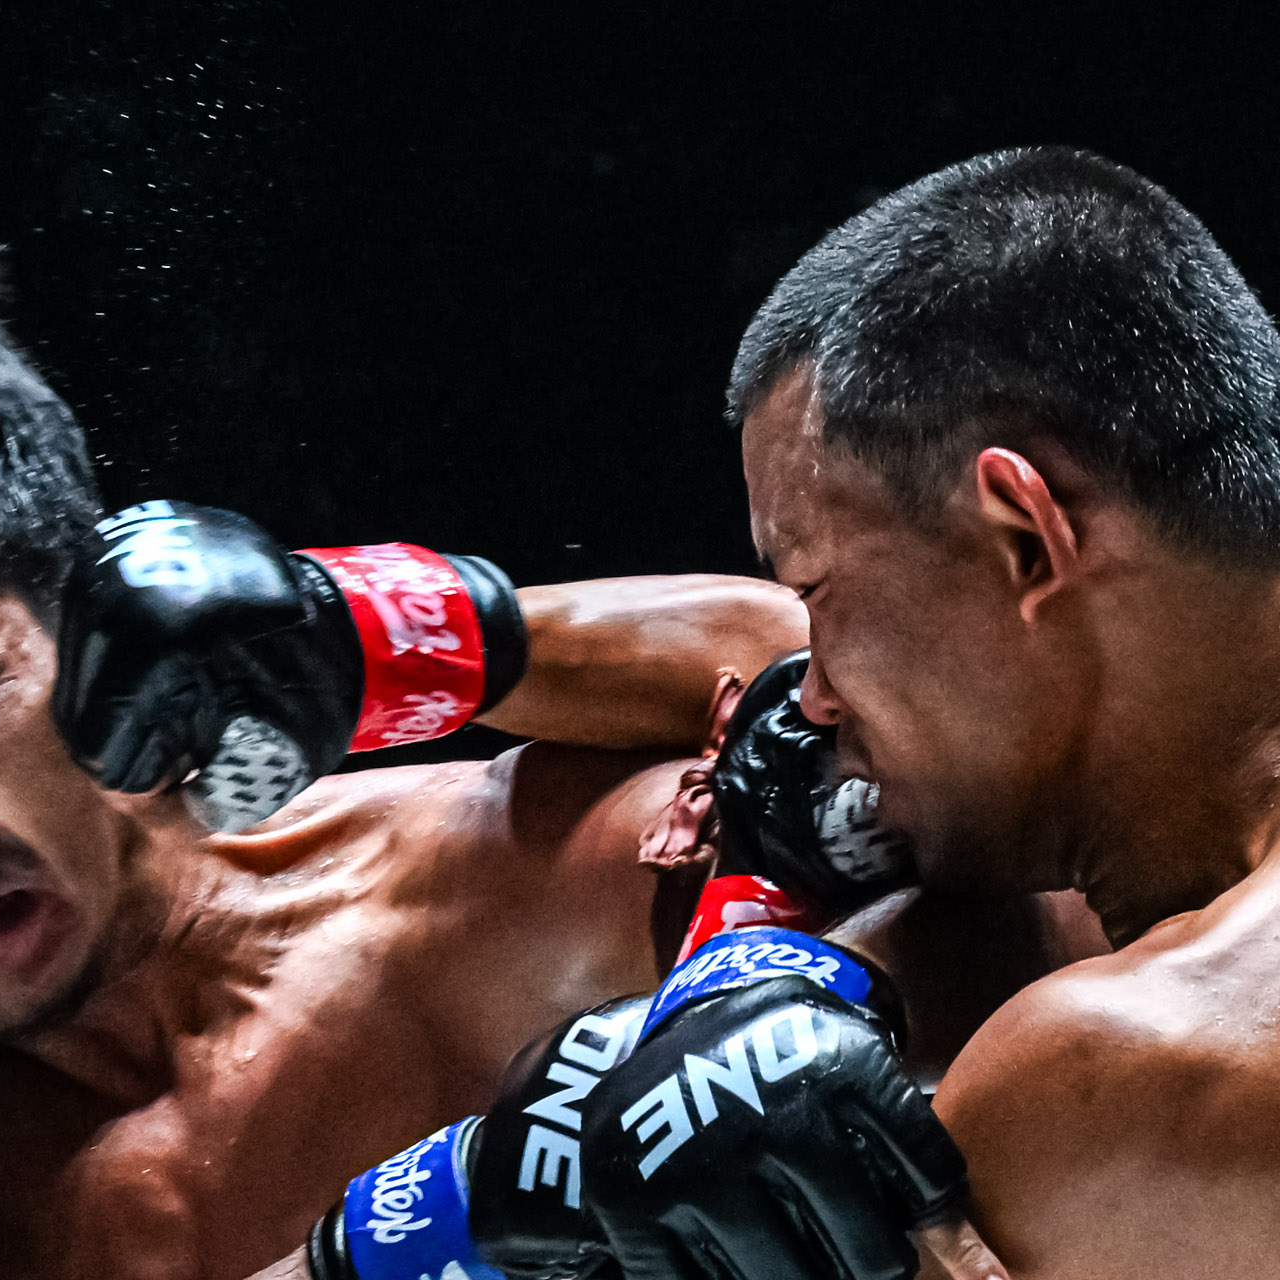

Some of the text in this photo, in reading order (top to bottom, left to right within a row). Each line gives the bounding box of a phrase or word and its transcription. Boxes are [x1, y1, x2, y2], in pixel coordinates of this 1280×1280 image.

[94, 500, 208, 589] ONE
[517, 1014, 626, 1210] ONE
[621, 1002, 818, 1181] ONE
